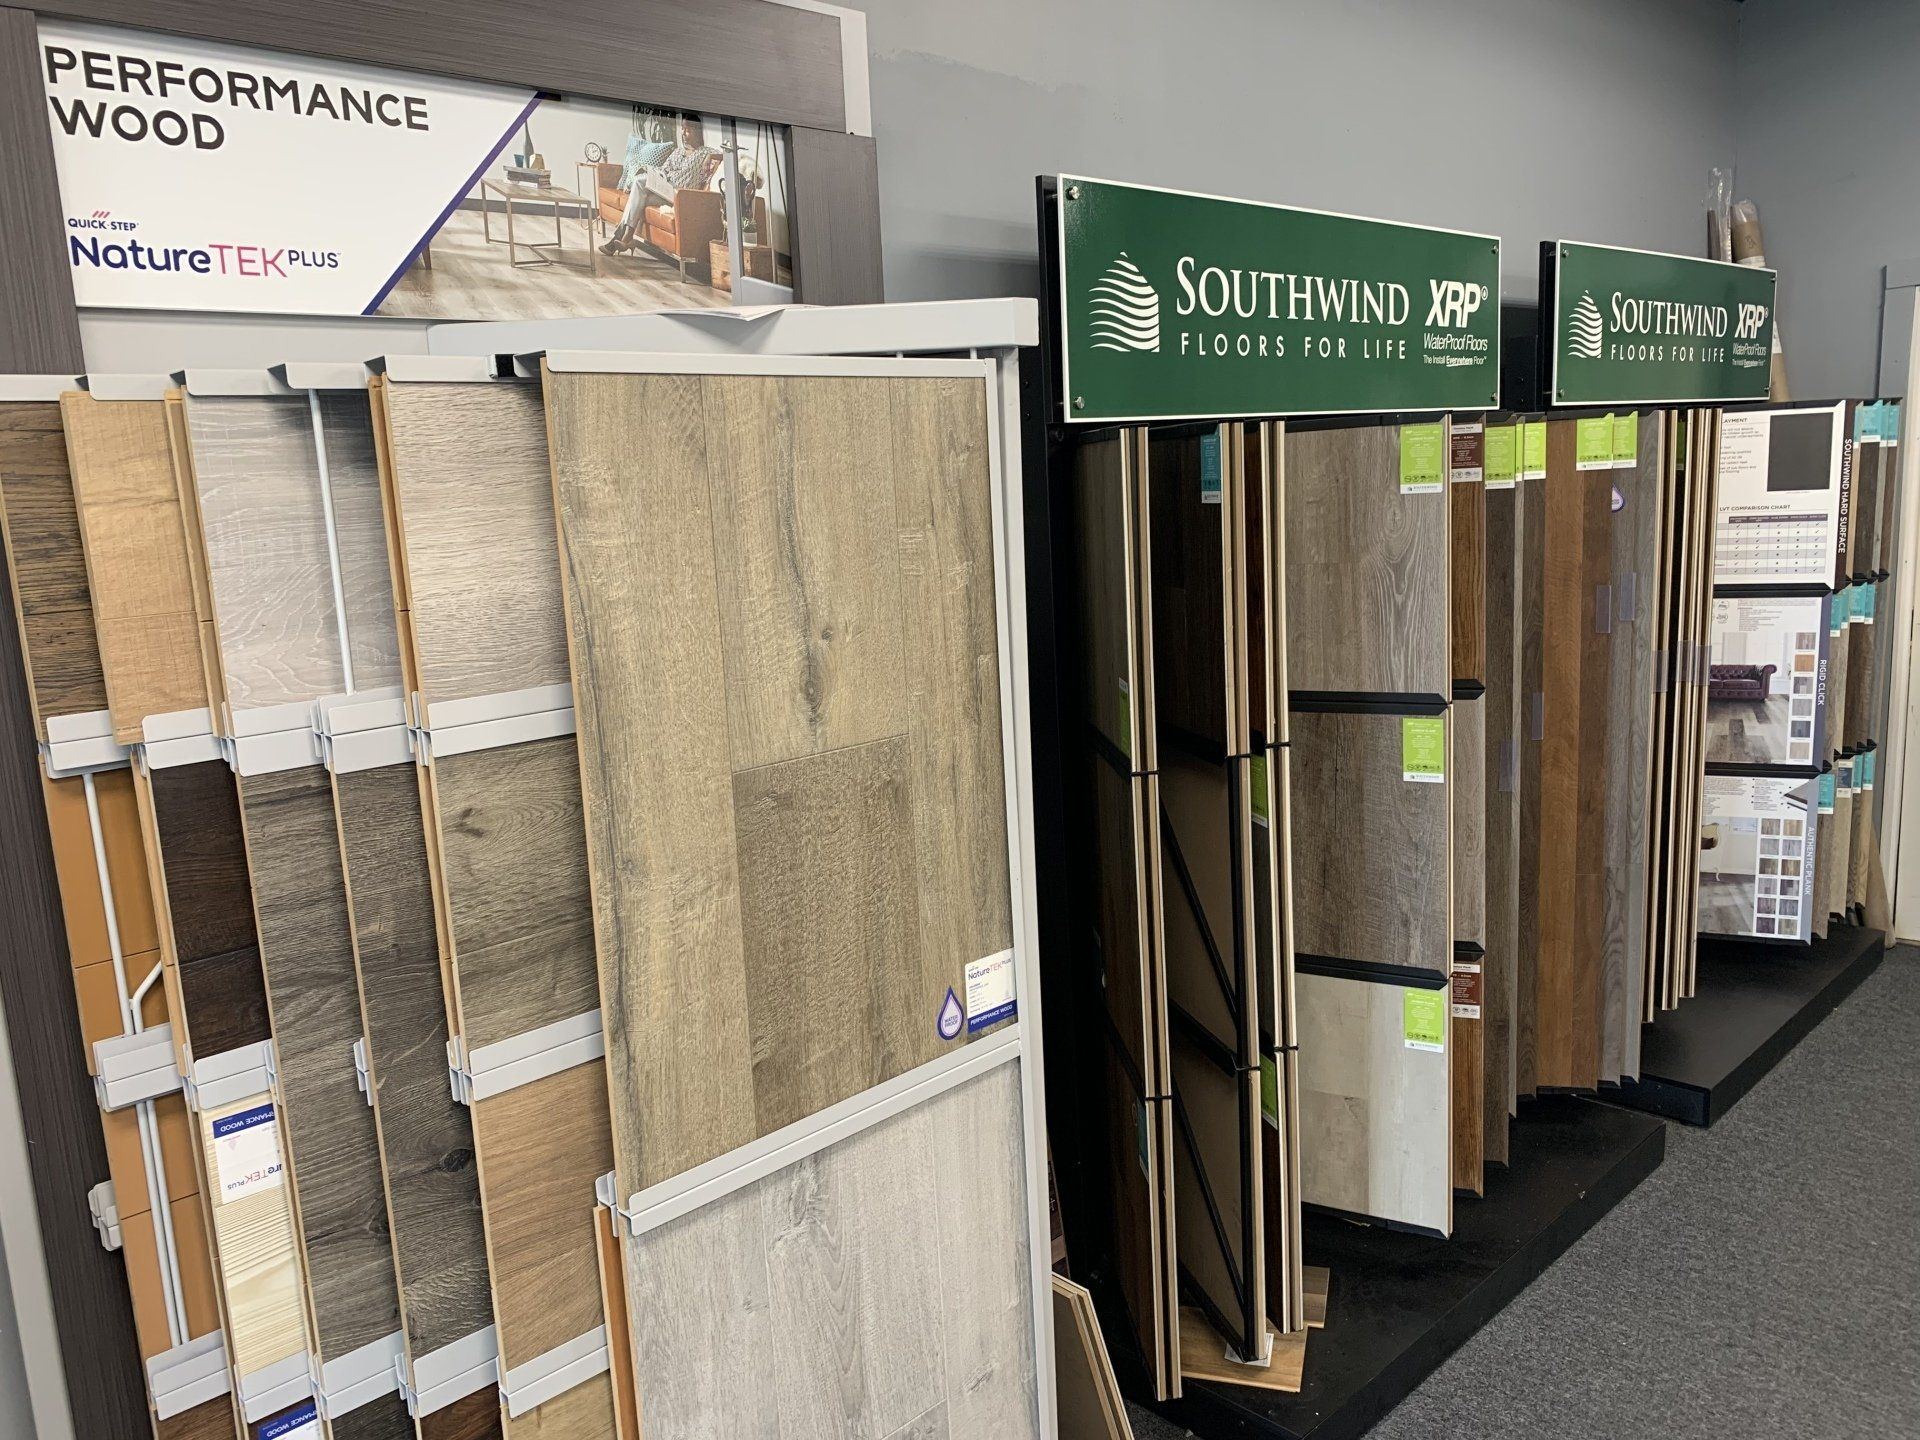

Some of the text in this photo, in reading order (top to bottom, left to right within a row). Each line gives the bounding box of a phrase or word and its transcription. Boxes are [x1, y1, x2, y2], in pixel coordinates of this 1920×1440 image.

[44, 45, 429, 132] PERFORMANCE
[49, 95, 225, 150] WOOD
[1175, 256, 1410, 325] SOUTHWIND
[1610, 291, 1728, 338] SOUTHWIND
[1181, 332, 1406, 360] FLOORS FOR LIFE
[1423, 354, 1432, 364] The
[1432, 355, 1446, 364] Install
[1424, 333, 1488, 351] WaterProof Floors
[1611, 344, 1724, 363] FLOORS FOR LIFE
[1837, 438, 1853, 554] SOUTHWIND HARD SURFACE
[1817, 659, 1828, 706] RIGID CLICK
[1804, 827, 1815, 895] AUTHENTIC PLANK
[970, 1009, 1000, 1025] PERFORMANCE
[1000, 1004, 1013, 1014] WOOD
[220, 1118, 244, 1132] WOOD
[266, 1423, 289, 1437] WOOD
